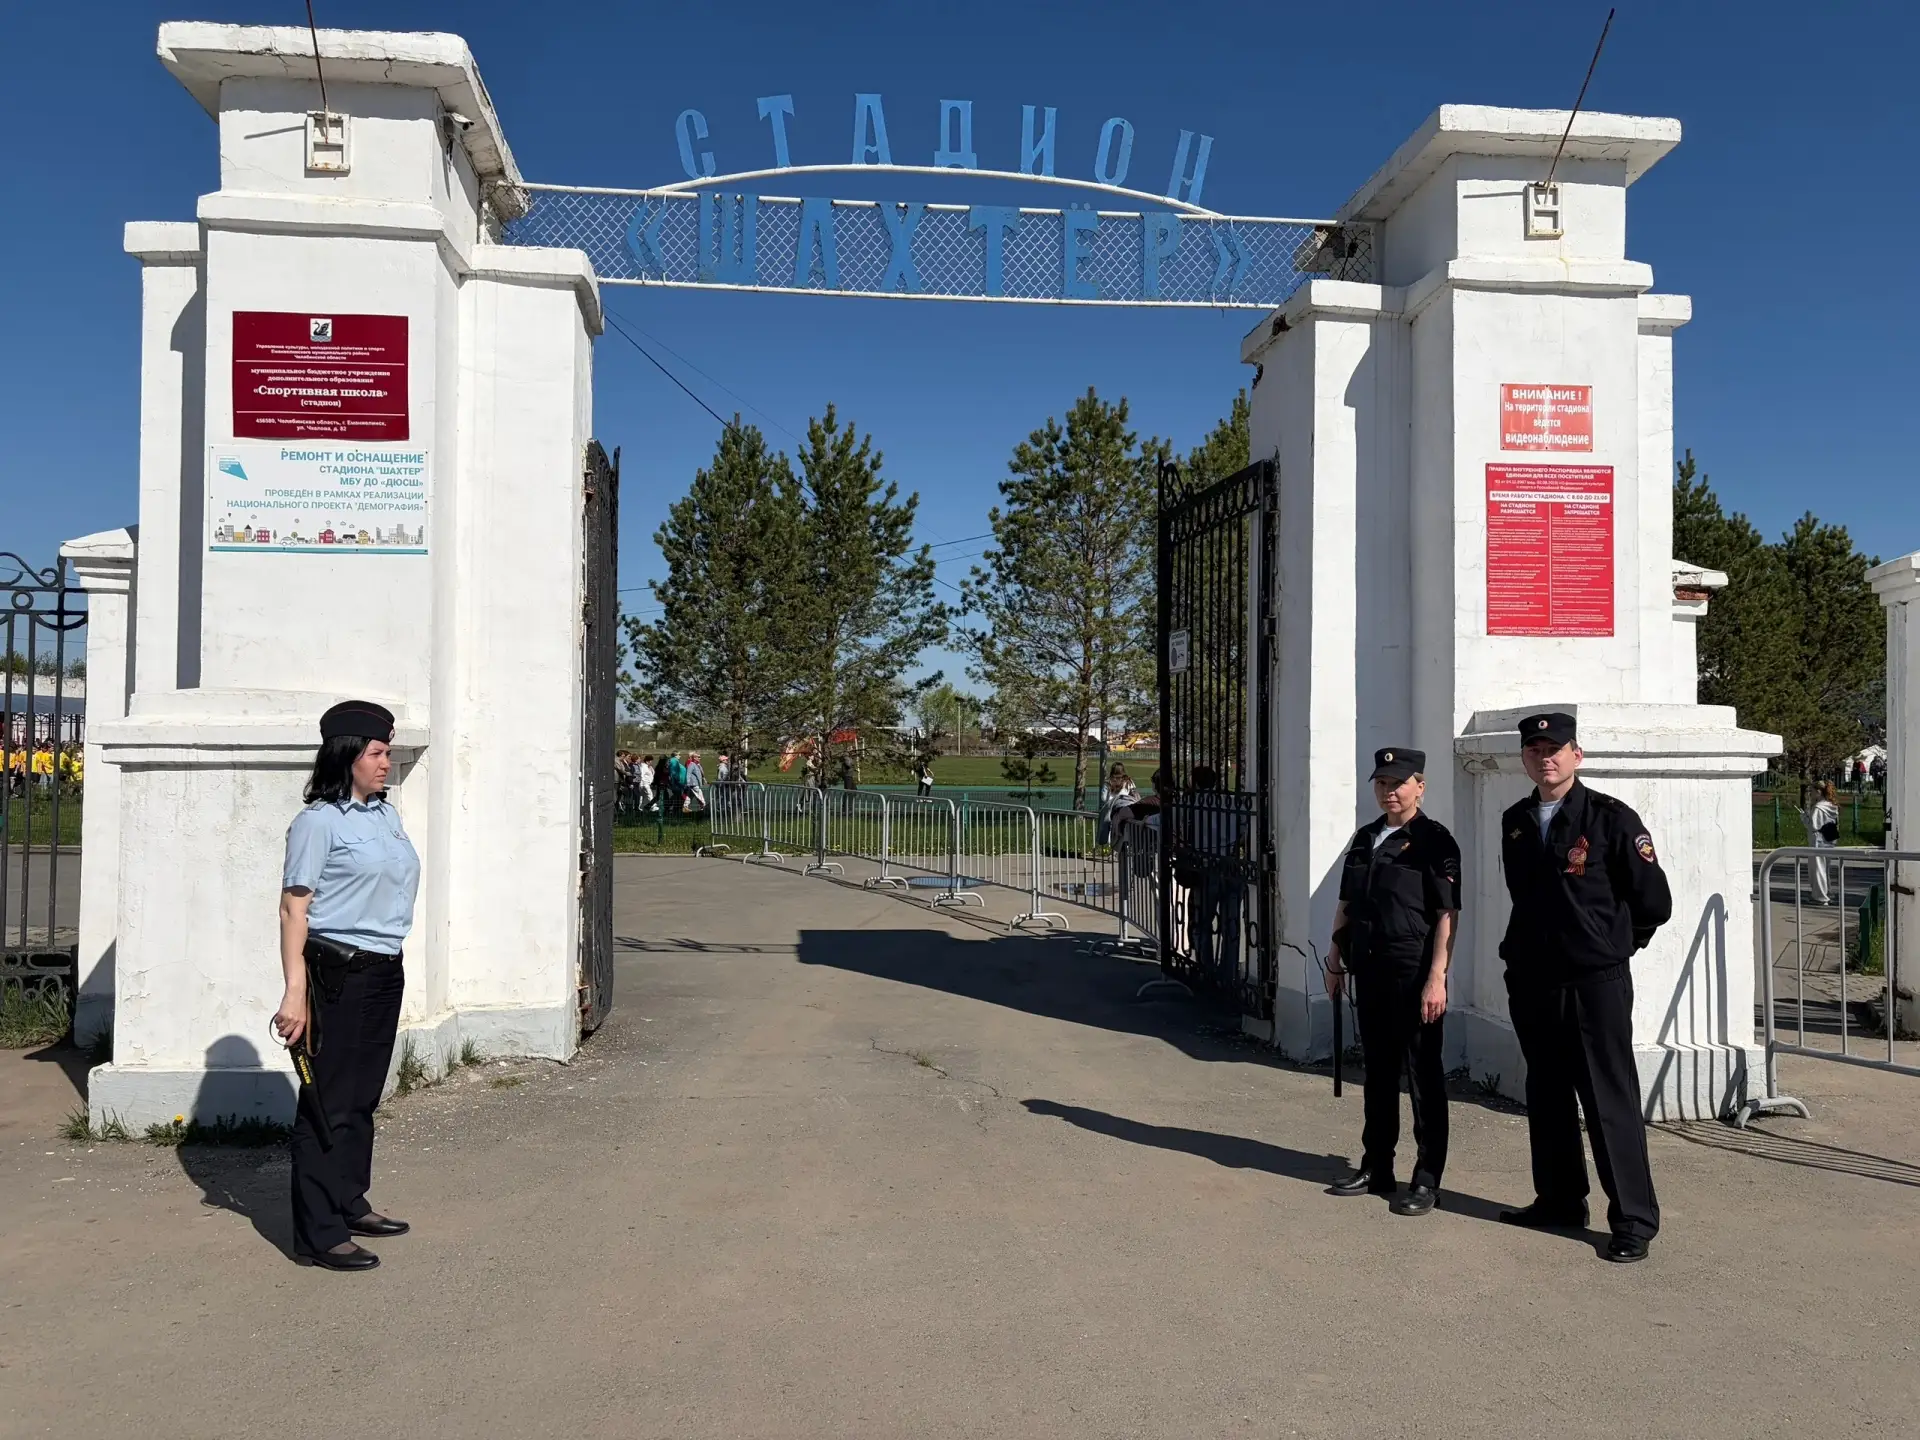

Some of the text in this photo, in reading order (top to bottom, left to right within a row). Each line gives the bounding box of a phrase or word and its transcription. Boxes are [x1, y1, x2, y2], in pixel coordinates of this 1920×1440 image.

[674, 93, 1215, 206] СТАДИОН
[307, 368, 346, 376] бюджетное
[254, 386, 387, 397] «Спортивная школа»
[1512, 389, 1581, 400] ВНИМАНИЕ !
[301, 399, 341, 407] (стадион)
[1505, 402, 1589, 415] На территории стадиона
[1505, 431, 1589, 447] видеонаблюдение
[281, 451, 424, 464] РЕМОНТ И ОСНАЩЕНИЕ
[320, 465, 424, 475] СТАДИОНА "ШАХТЕР"
[340, 478, 423, 487] МБУ ДО «ДЮСШ»
[265, 489, 424, 500] ПРОВЕДЁН В РАМКАХ РЕАЛИЗАЦИИ
[227, 500, 309, 509] НАЦИОНАЛЬНОГО
[312, 501, 352, 510] ПРОЕКТА
